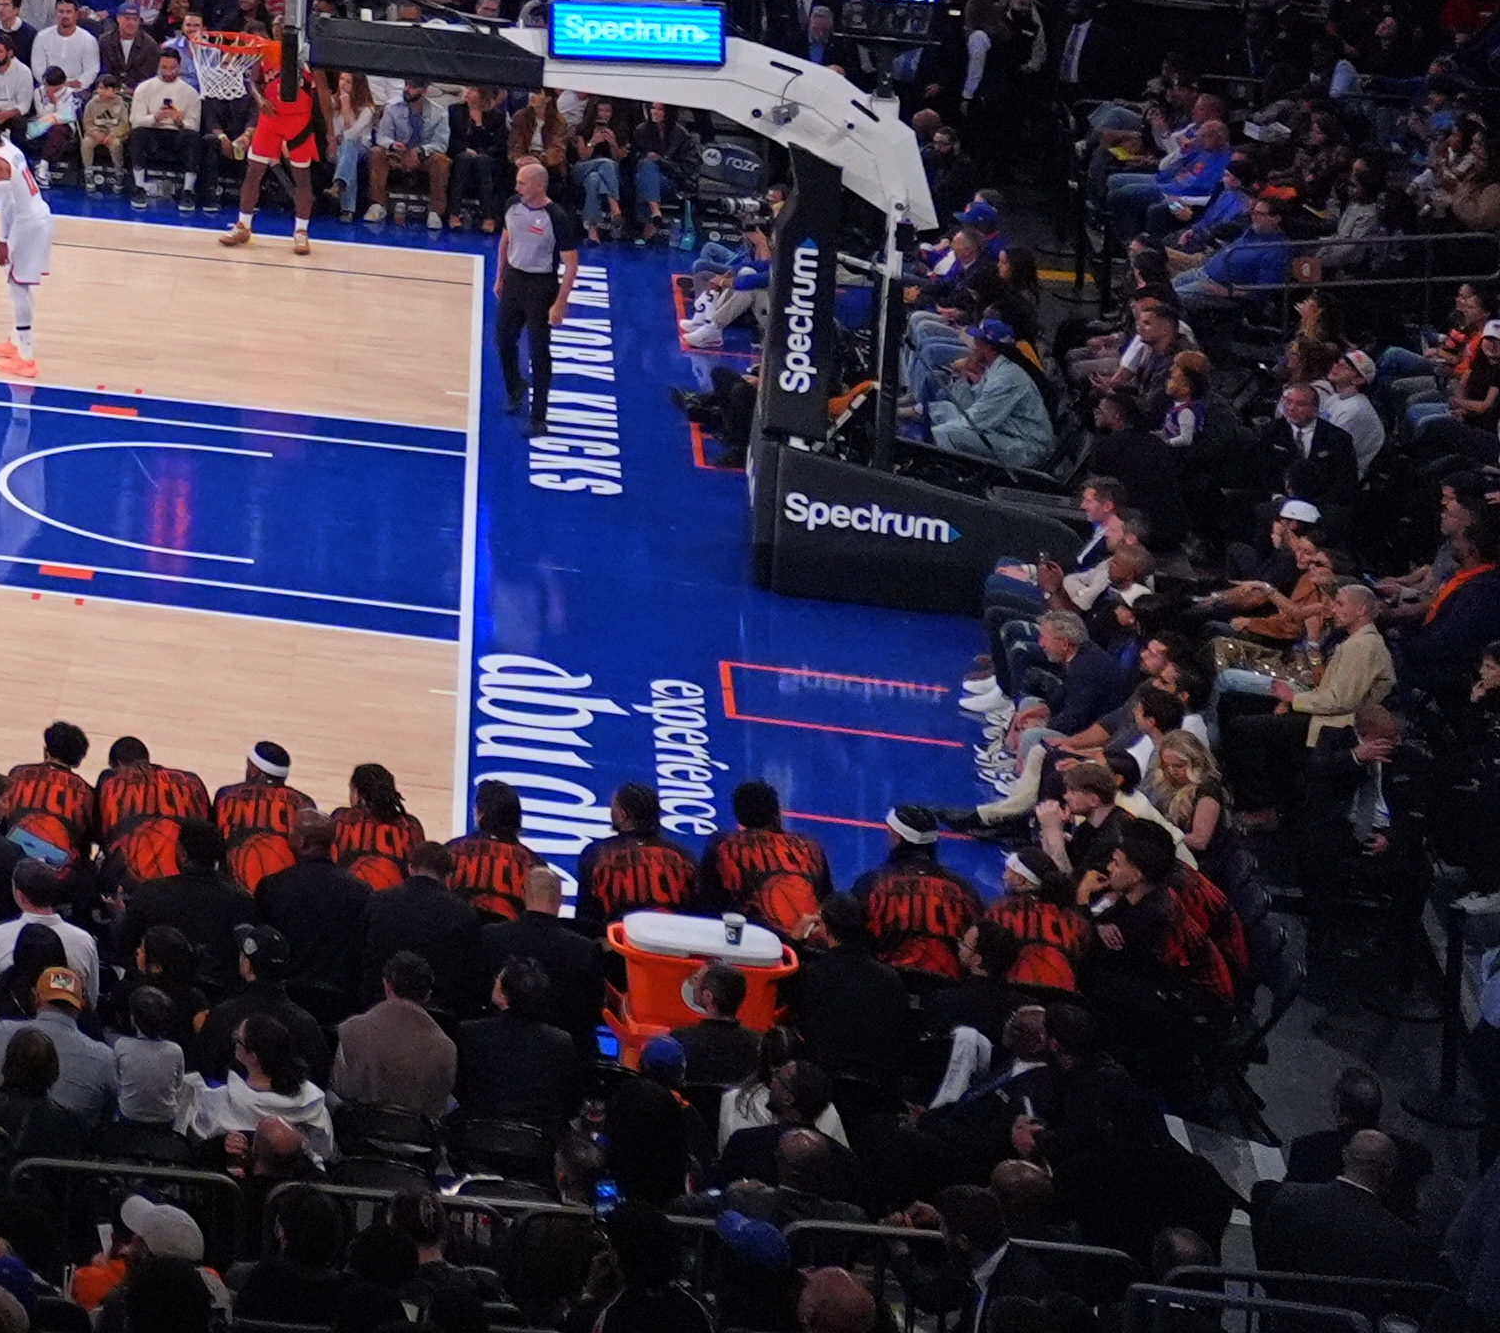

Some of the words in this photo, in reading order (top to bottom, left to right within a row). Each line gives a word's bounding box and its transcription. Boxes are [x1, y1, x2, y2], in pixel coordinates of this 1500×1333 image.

[564, 14, 703, 45] Spectrum
[779, 247, 820, 394] Spectrum
[528, 388, 624, 496] KNICKS
[784, 491, 950, 544] Spectrum
[474, 653, 631, 769] abu
[630, 676, 730, 835] experience
